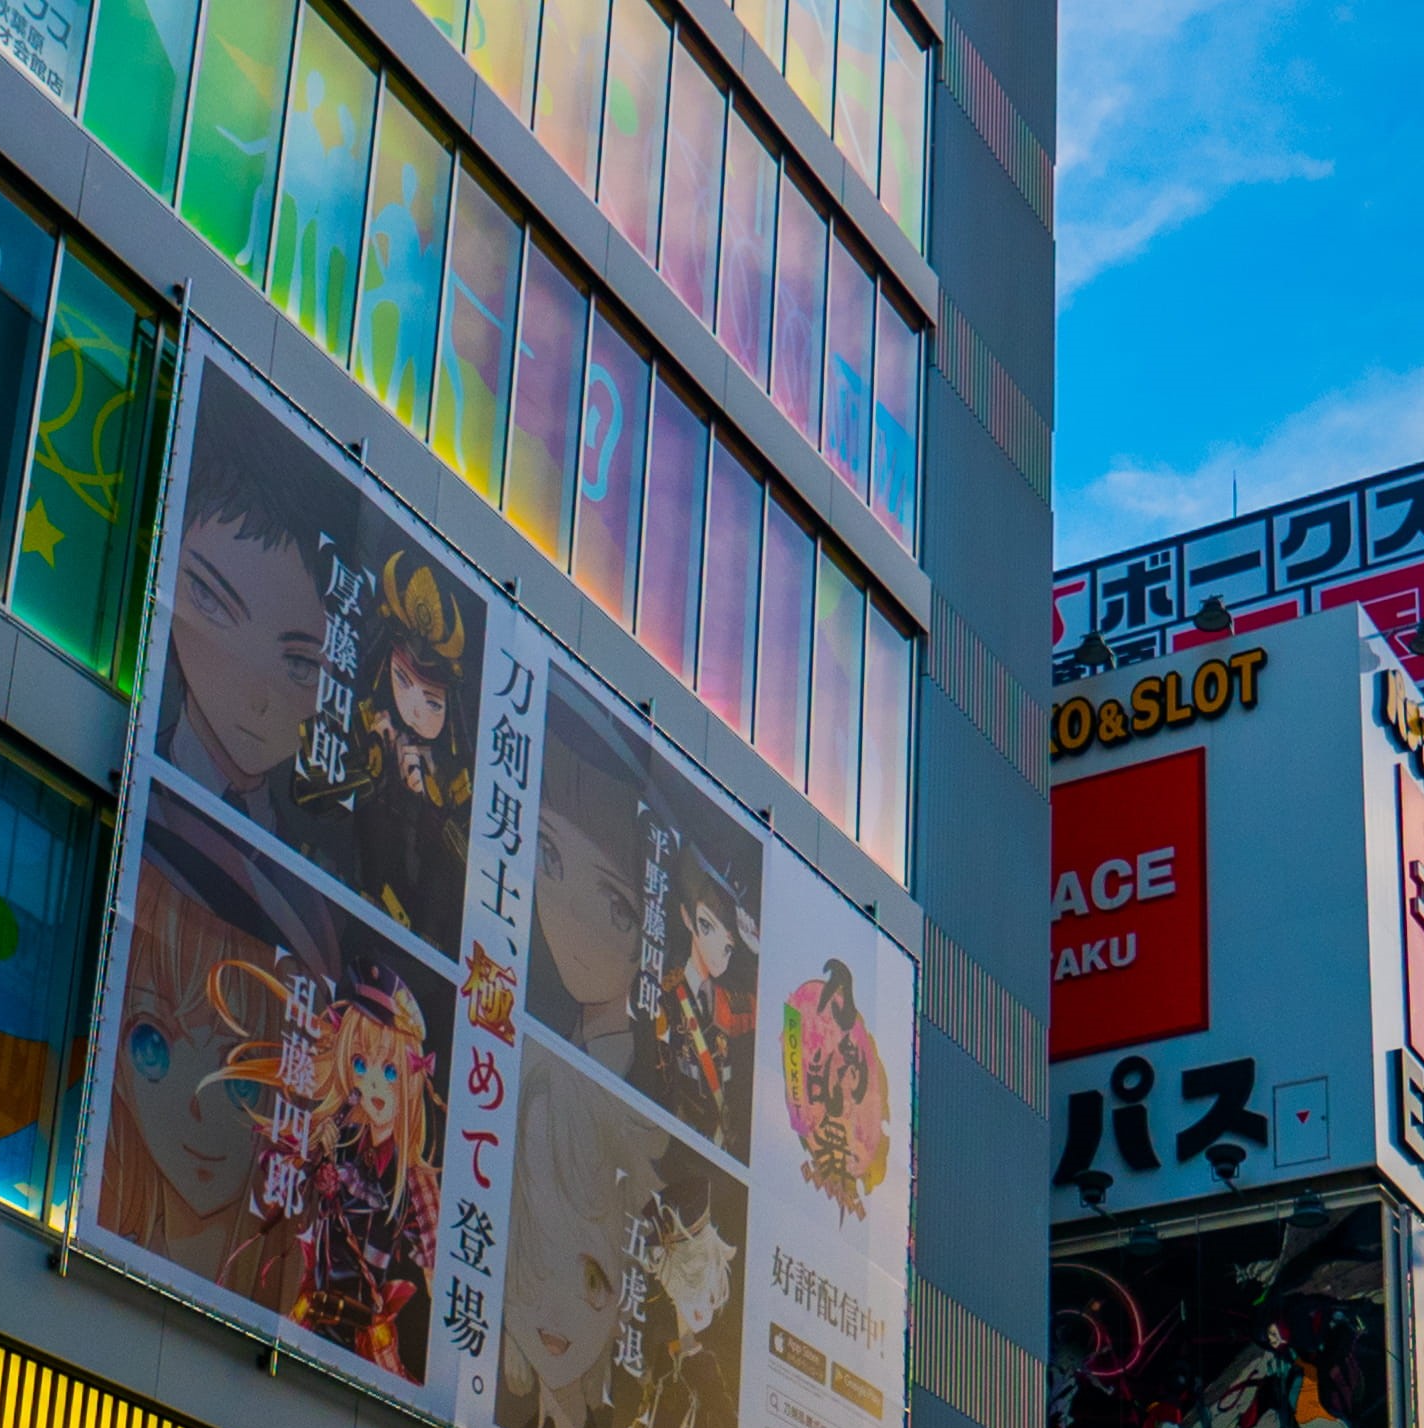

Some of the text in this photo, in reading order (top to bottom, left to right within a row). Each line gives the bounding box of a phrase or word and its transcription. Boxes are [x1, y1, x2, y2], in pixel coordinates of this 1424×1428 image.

[308, 554, 363, 784] 厚藤四郎
[1051, 932, 1137, 982] AKU
[262, 974, 323, 1221] 乱藤四郎
[612, 1211, 653, 1380] 五虎退
